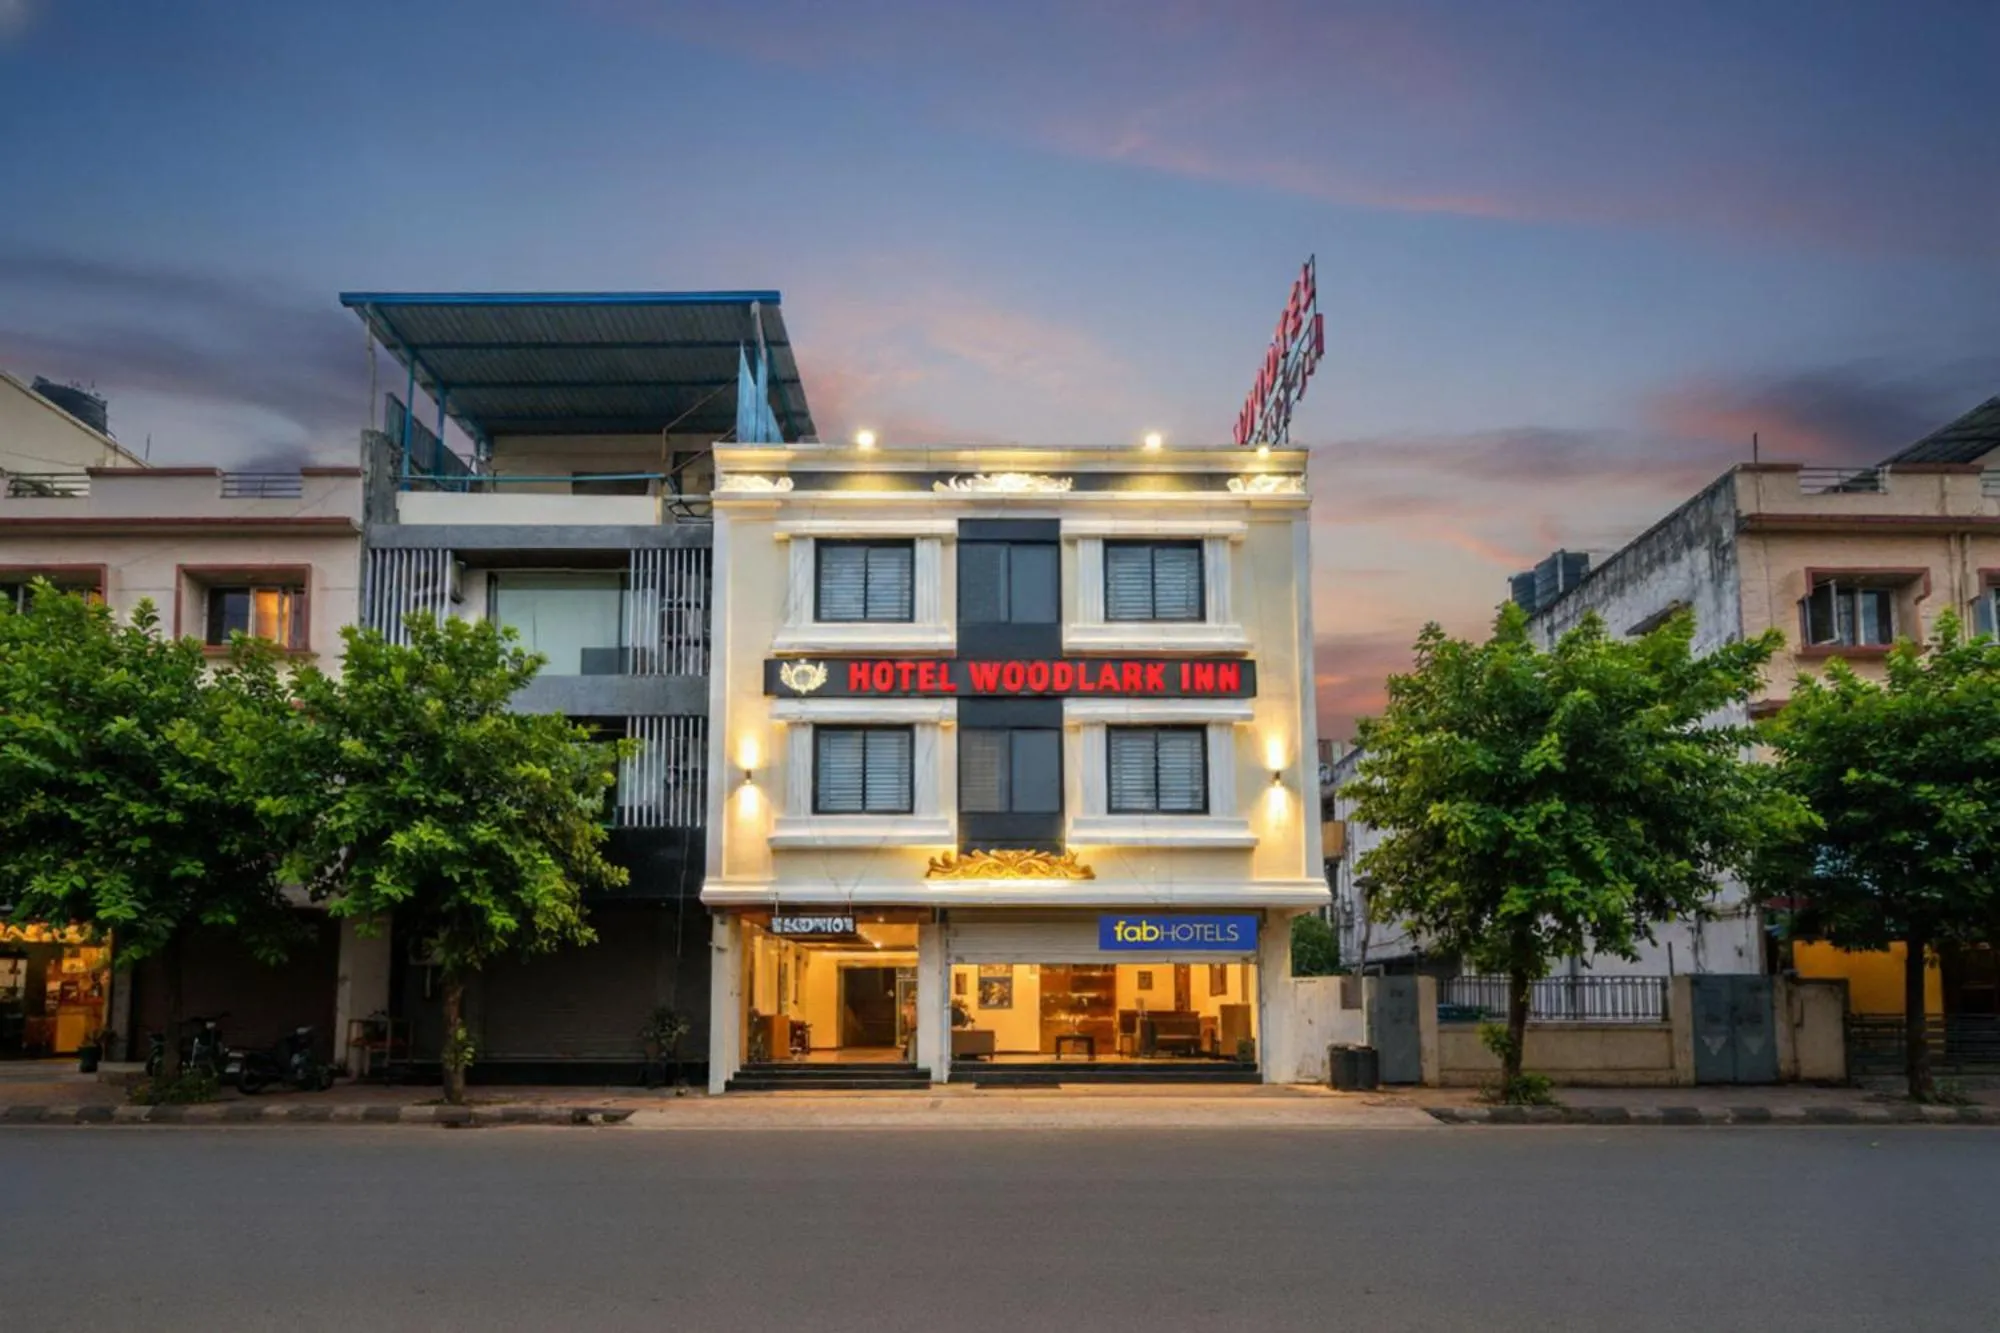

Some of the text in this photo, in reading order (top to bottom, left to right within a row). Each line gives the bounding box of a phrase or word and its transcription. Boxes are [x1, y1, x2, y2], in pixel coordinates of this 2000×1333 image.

[848, 661, 1240, 692] HOTEL WOODLARK INN
[772, 917, 854, 933] ECTIO
